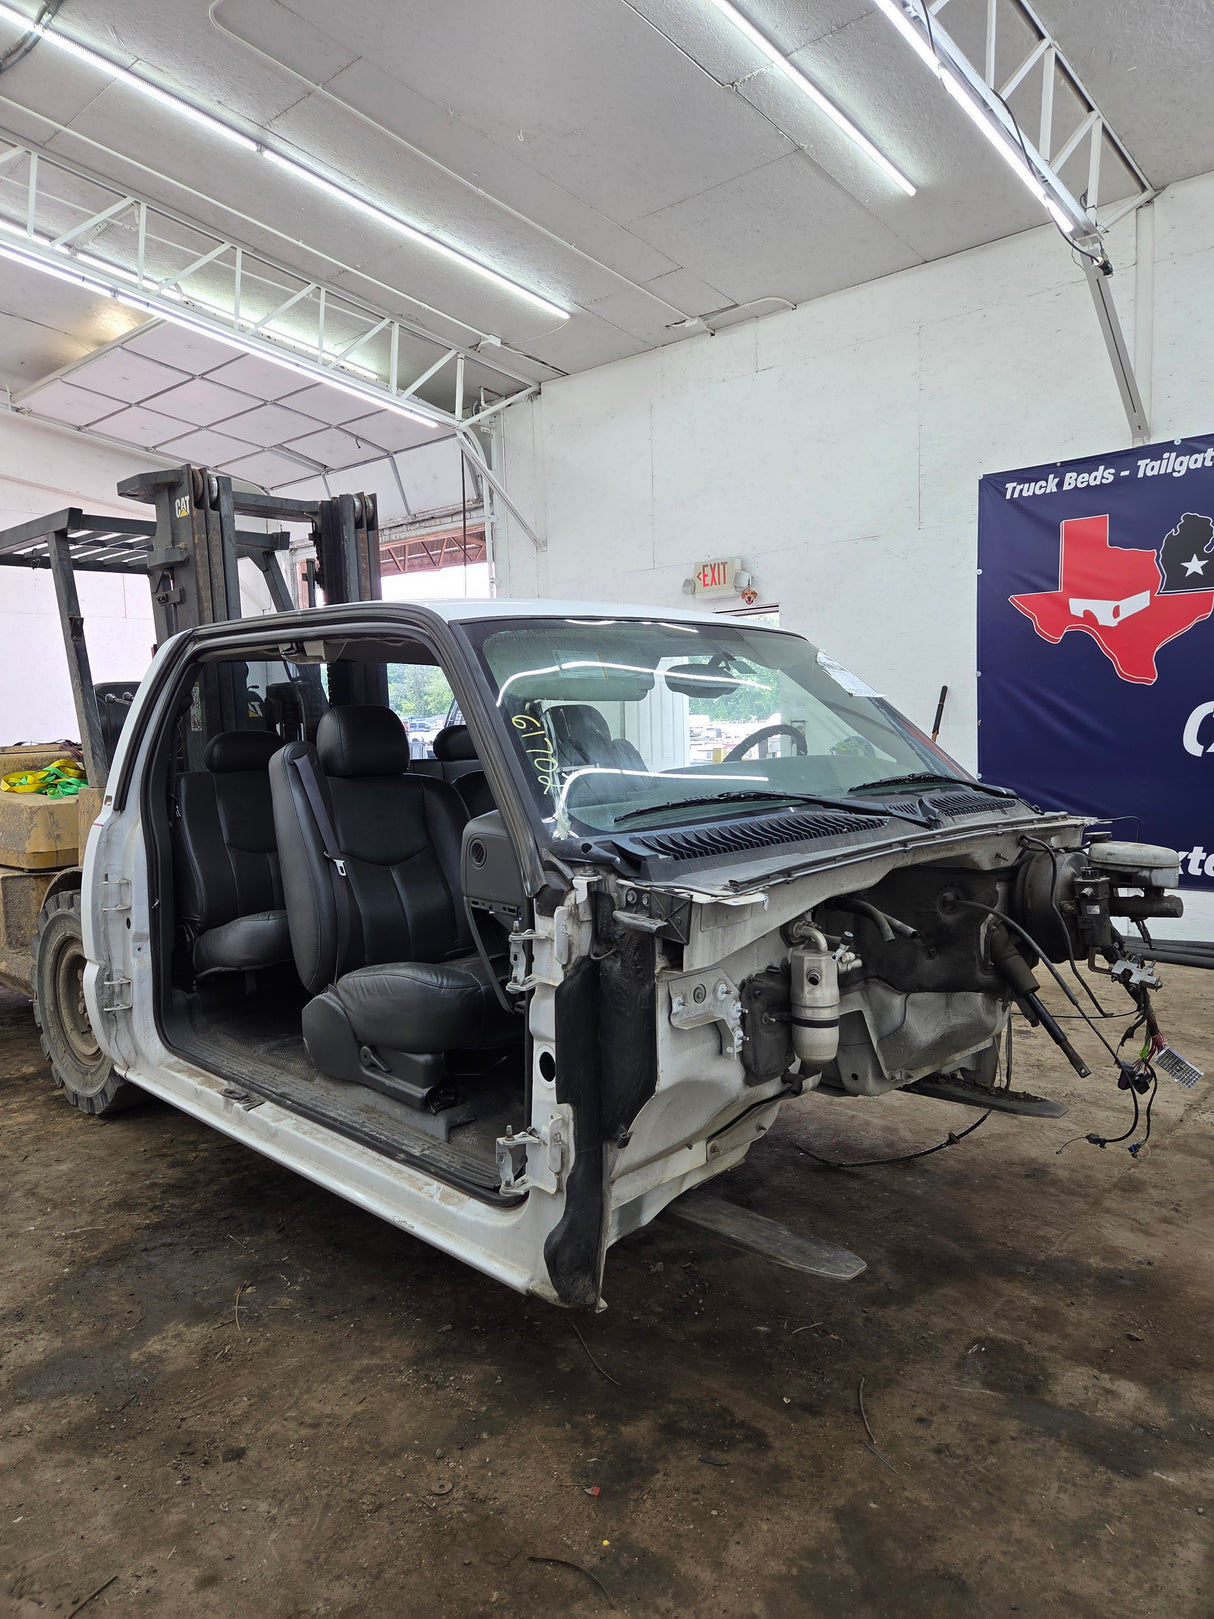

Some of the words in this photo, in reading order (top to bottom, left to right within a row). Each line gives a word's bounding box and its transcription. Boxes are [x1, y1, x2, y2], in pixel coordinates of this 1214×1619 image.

[1005, 474, 1060, 500] Truck
[1062, 465, 1116, 491] Beds
[175, 494, 190, 518] CAT
[702, 561, 728, 587] EXIT
